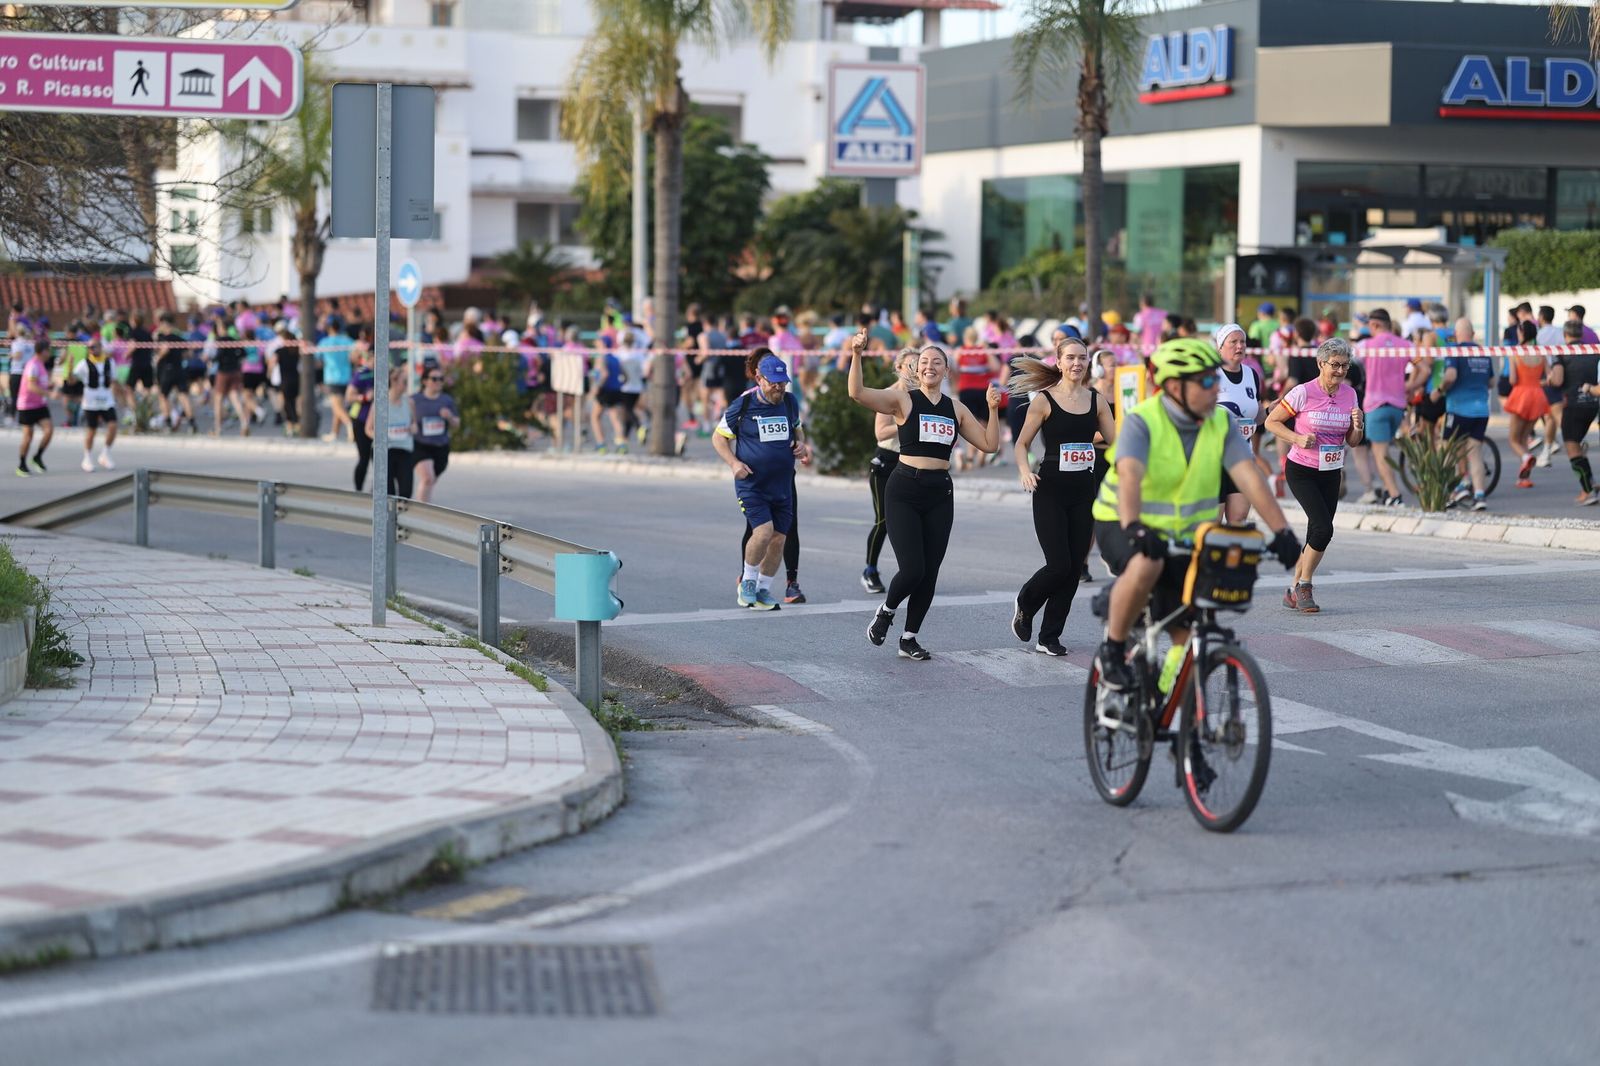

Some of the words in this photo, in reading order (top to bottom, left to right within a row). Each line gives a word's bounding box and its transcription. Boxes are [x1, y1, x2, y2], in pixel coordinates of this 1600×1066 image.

[28, 53, 104, 72] Cultural
[1138, 24, 1231, 92] ALDI
[17, 79, 33, 96] R.
[44, 80, 113, 98] Picasso
[1442, 55, 1600, 107] ALD
[840, 143, 909, 161] ALDI
[1308, 411, 1328, 421] MEDIA
[761, 423, 788, 434] 1536
[923, 422, 953, 436] 1135
[1063, 450, 1094, 462] 1643
[1325, 451, 1341, 462] 682
